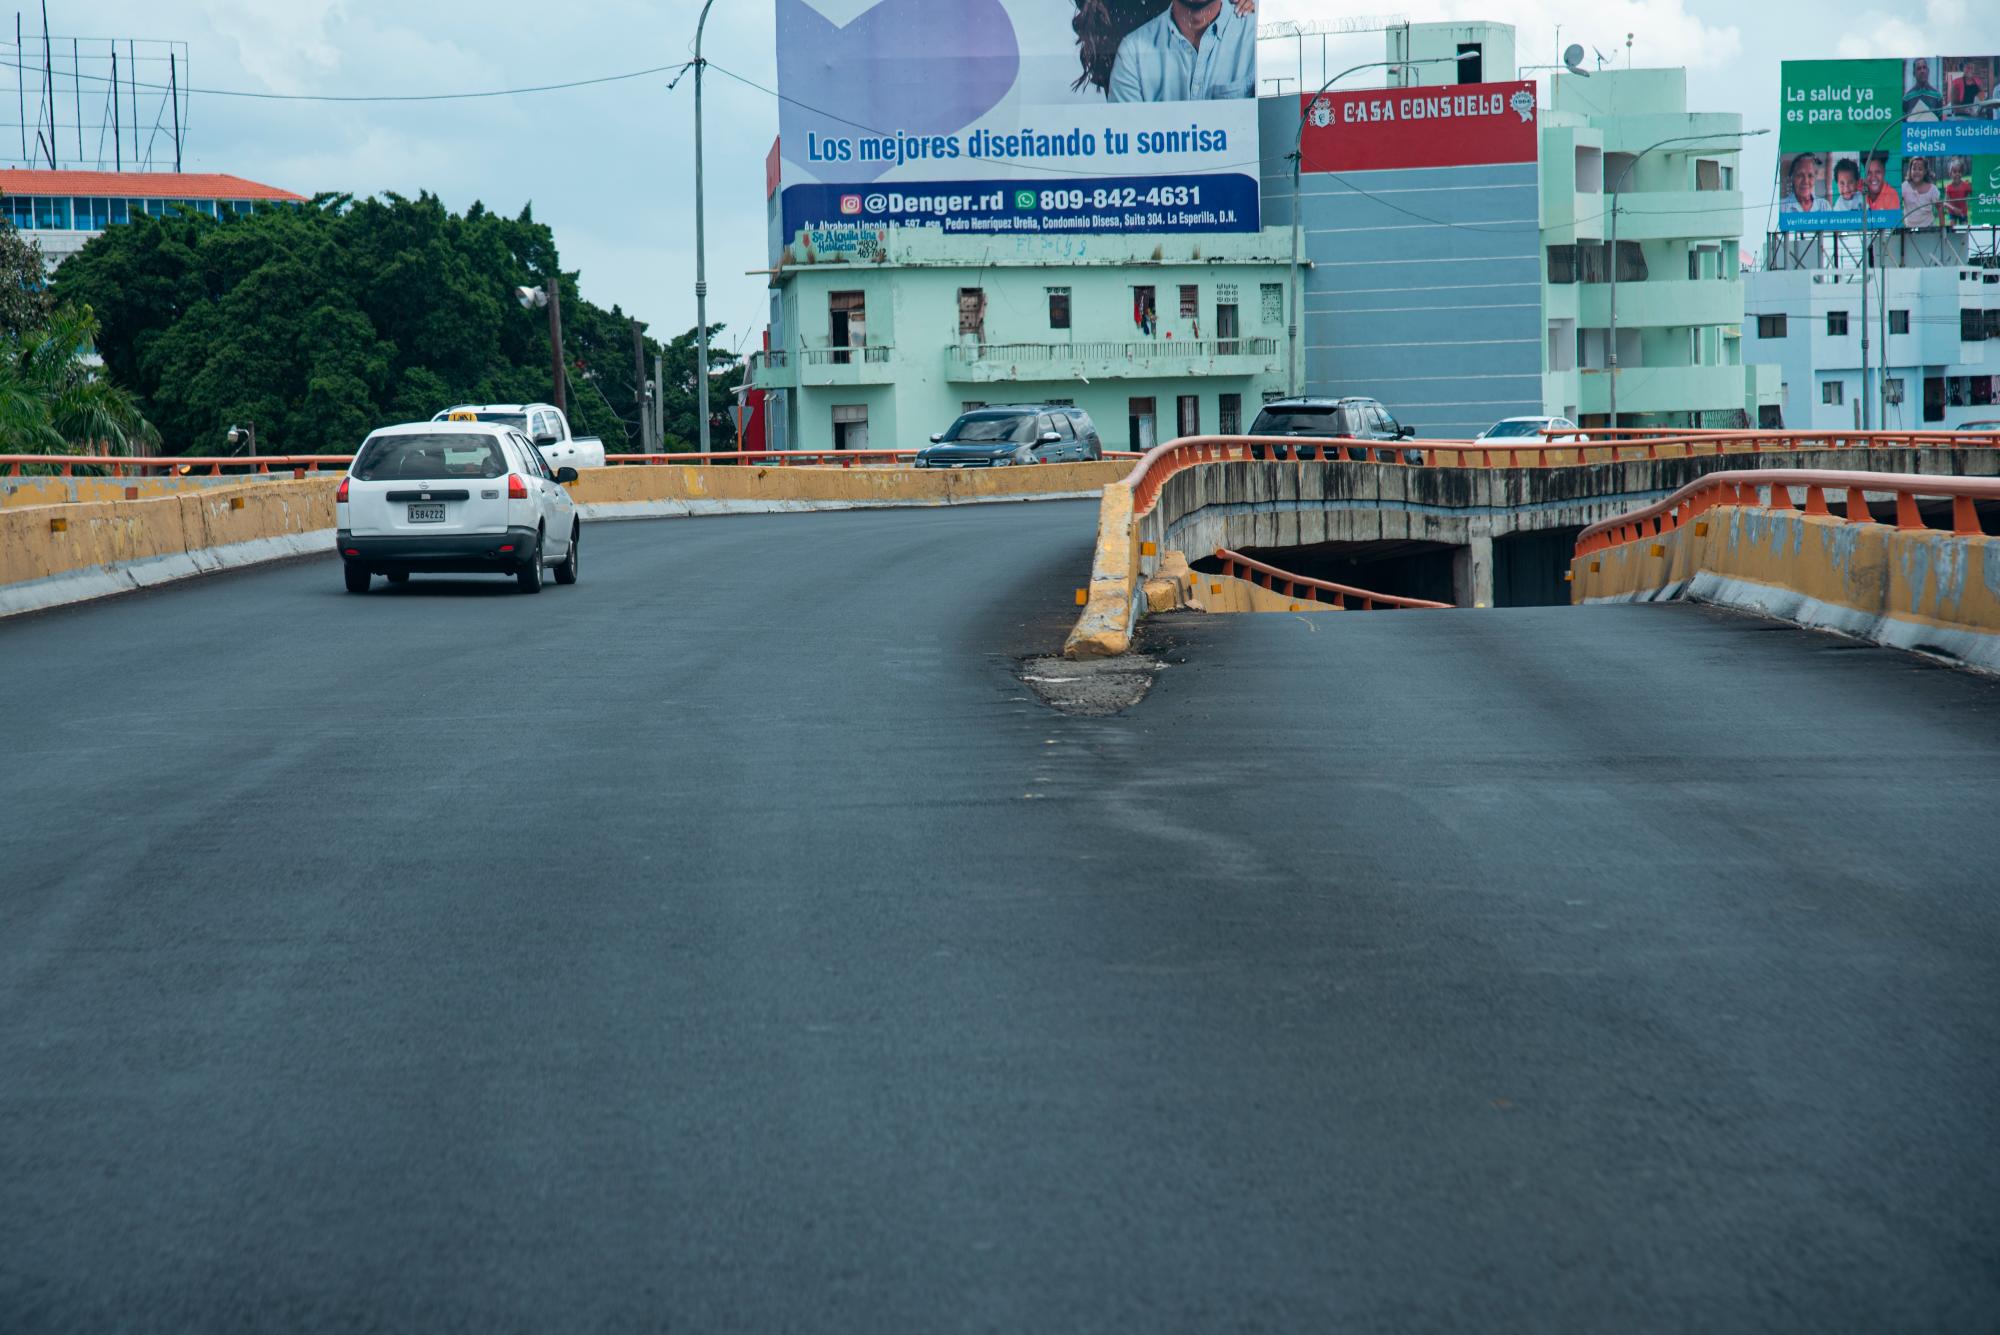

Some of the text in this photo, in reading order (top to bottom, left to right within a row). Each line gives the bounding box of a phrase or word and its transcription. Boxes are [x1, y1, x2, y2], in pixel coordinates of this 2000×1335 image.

[1787, 84, 1874, 104] La salud ya
[1343, 99, 1396, 123] CASA
[1400, 93, 1504, 120] CONSUELO
[1786, 104, 1892, 125] es para todos
[1906, 126, 1953, 140] Régimen
[808, 124, 1228, 166] Los mejores diseñando tu sonrisa
[1906, 141, 1946, 152] SeNaSa
[864, 191, 1004, 215] @Denger.rd
[1040, 186, 1200, 211] 809-842-4631
[819, 220, 856, 231] Abraham
[857, 219, 888, 230] Lincoln
[945, 217, 970, 230] Pedro
[971, 216, 1012, 232] Henríquez
[1013, 215, 1041, 231] Ureña,
[1042, 215, 1091, 230] Condominio
[1092, 214, 1122, 228] Disesa,
[1124, 213, 1146, 226] Suite
[1167, 212, 1178, 225] La
[1179, 211, 1218, 226] Esperilla,
[1219, 210, 1237, 223] D.N.
[812, 230, 877, 243] Se Alquila Una
